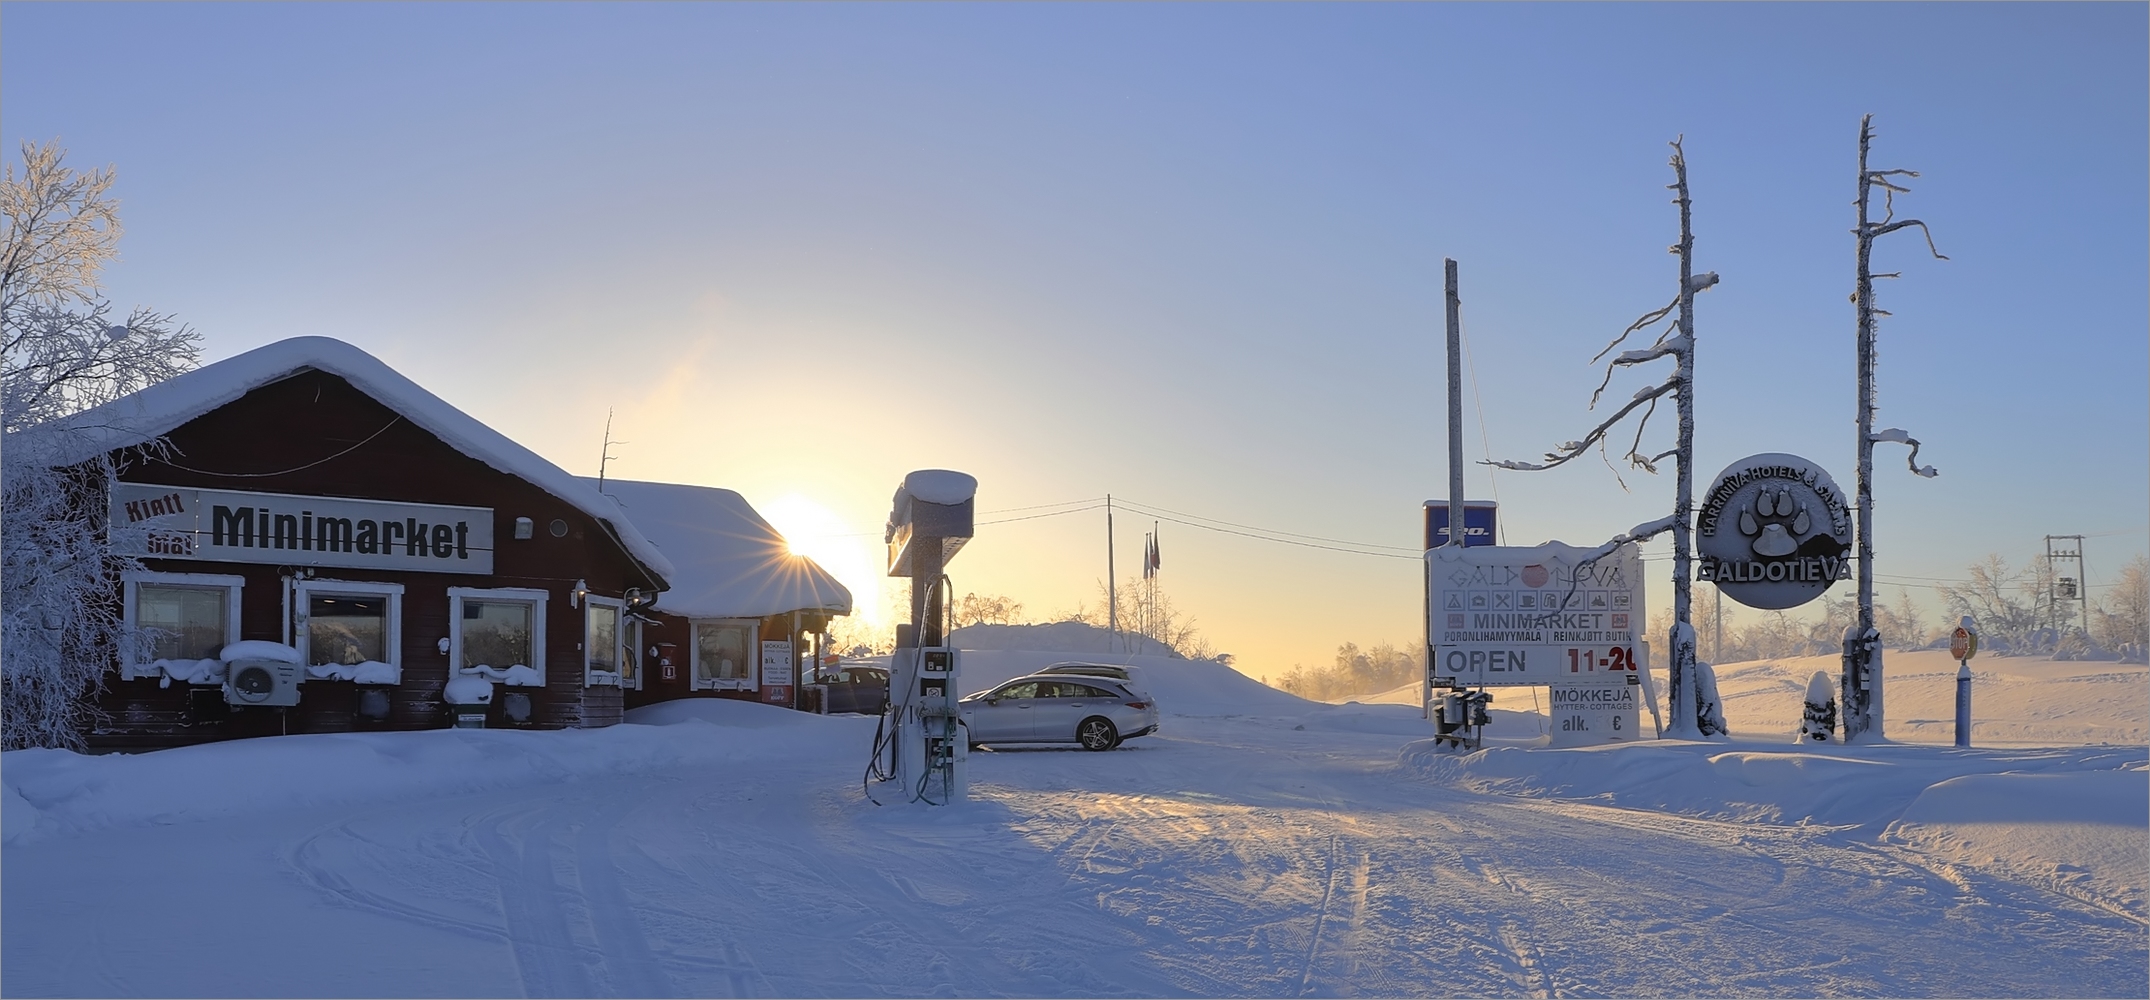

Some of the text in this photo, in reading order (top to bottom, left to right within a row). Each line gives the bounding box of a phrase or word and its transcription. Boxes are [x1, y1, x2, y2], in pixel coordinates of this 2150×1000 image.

[1703, 473, 1749, 537] HARRINIVA
[1750, 465, 1802, 481] HOTELS
[1804, 476, 1815, 486] &
[212, 505, 469, 560] Minimarket
[1697, 561, 1853, 582] GALDOTIEVA
[1474, 613, 1603, 629] MINIMARKET
[1444, 629, 1542, 642] PORONLIHAMYYMÄLÄ
[1553, 631, 1602, 642] REINKJØTT
[1446, 650, 1526, 673] OPEN
[1554, 687, 1632, 702] MÖKKEJÄ
[1562, 715, 1589, 731] alk.
[1612, 715, 1622, 731] €
